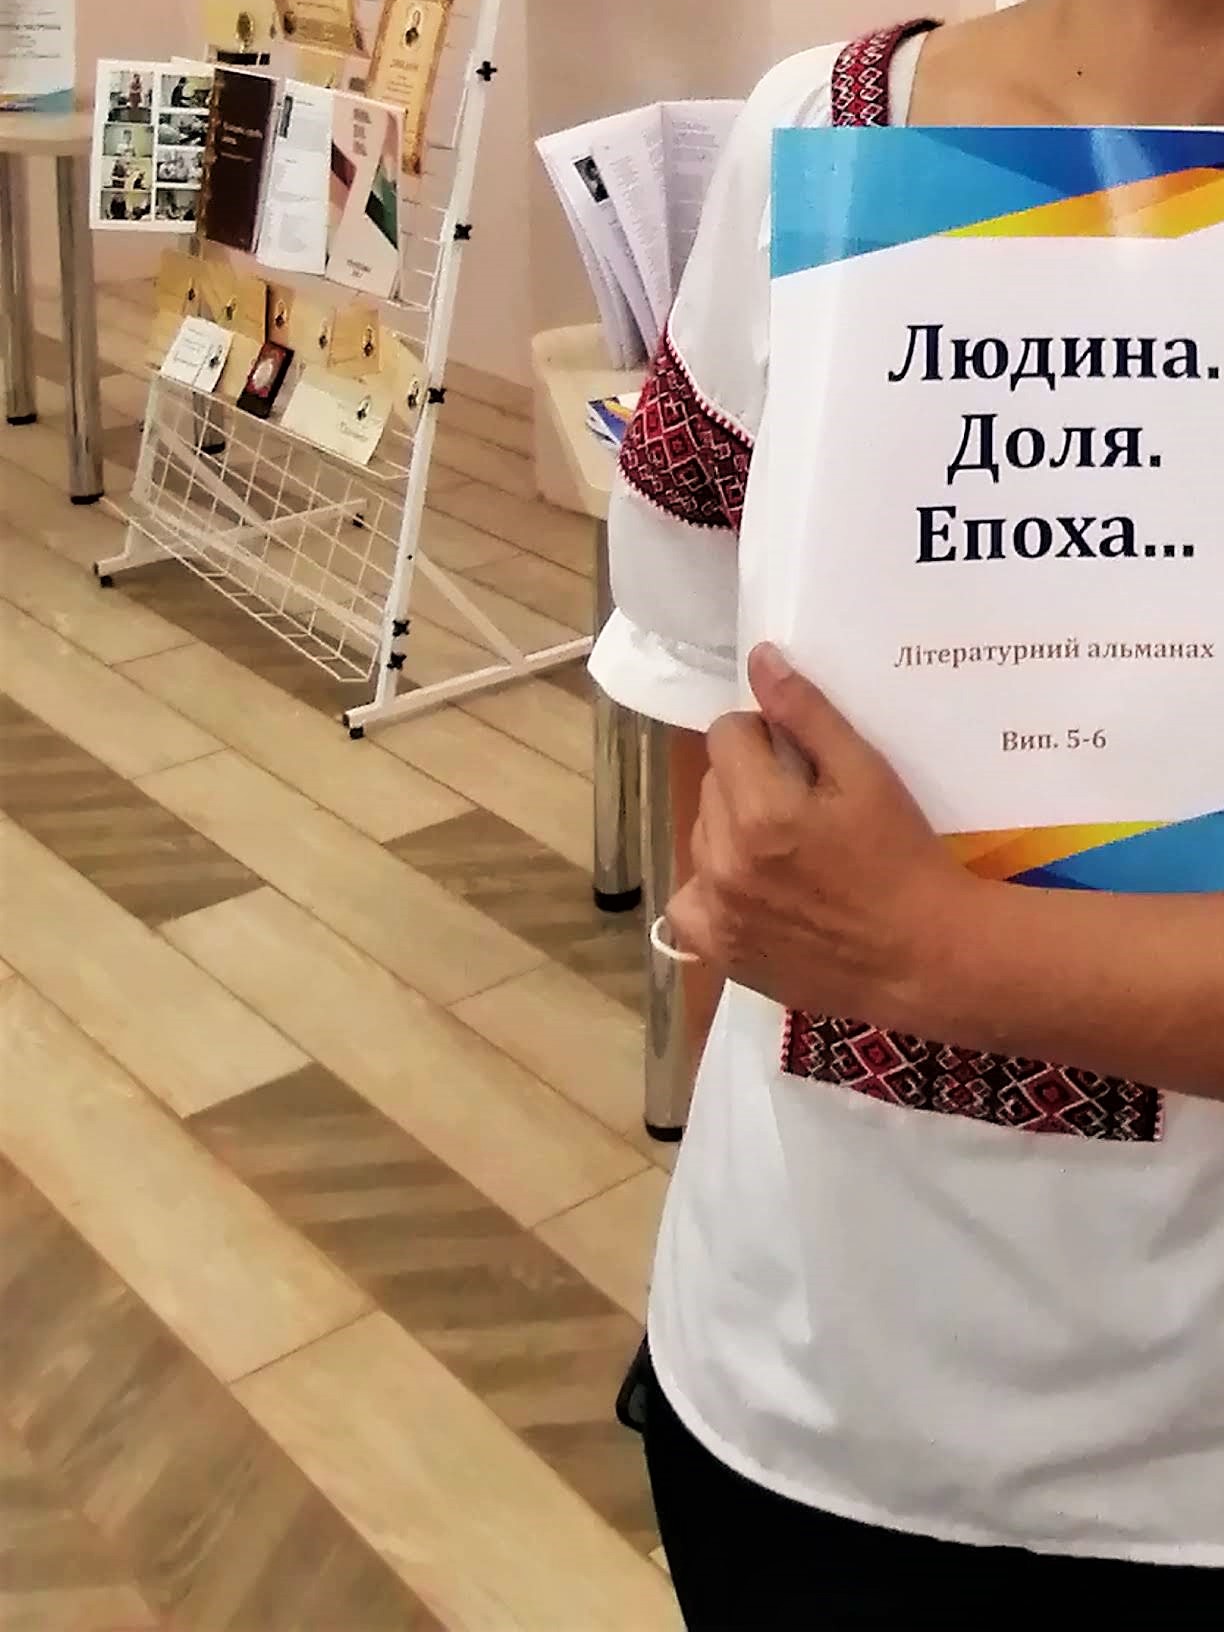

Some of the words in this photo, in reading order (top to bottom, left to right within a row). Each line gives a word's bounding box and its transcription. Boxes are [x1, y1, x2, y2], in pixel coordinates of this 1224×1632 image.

[888, 324, 1220, 393] Людина.
[947, 413, 1162, 484] Доля.
[916, 505, 1195, 564] Епоха...
[893, 636, 1080, 669] Літературний
[1087, 641, 1215, 664] альманах
[1002, 729, 1060, 754] Вип.
[1066, 728, 1107, 752] 5-6
